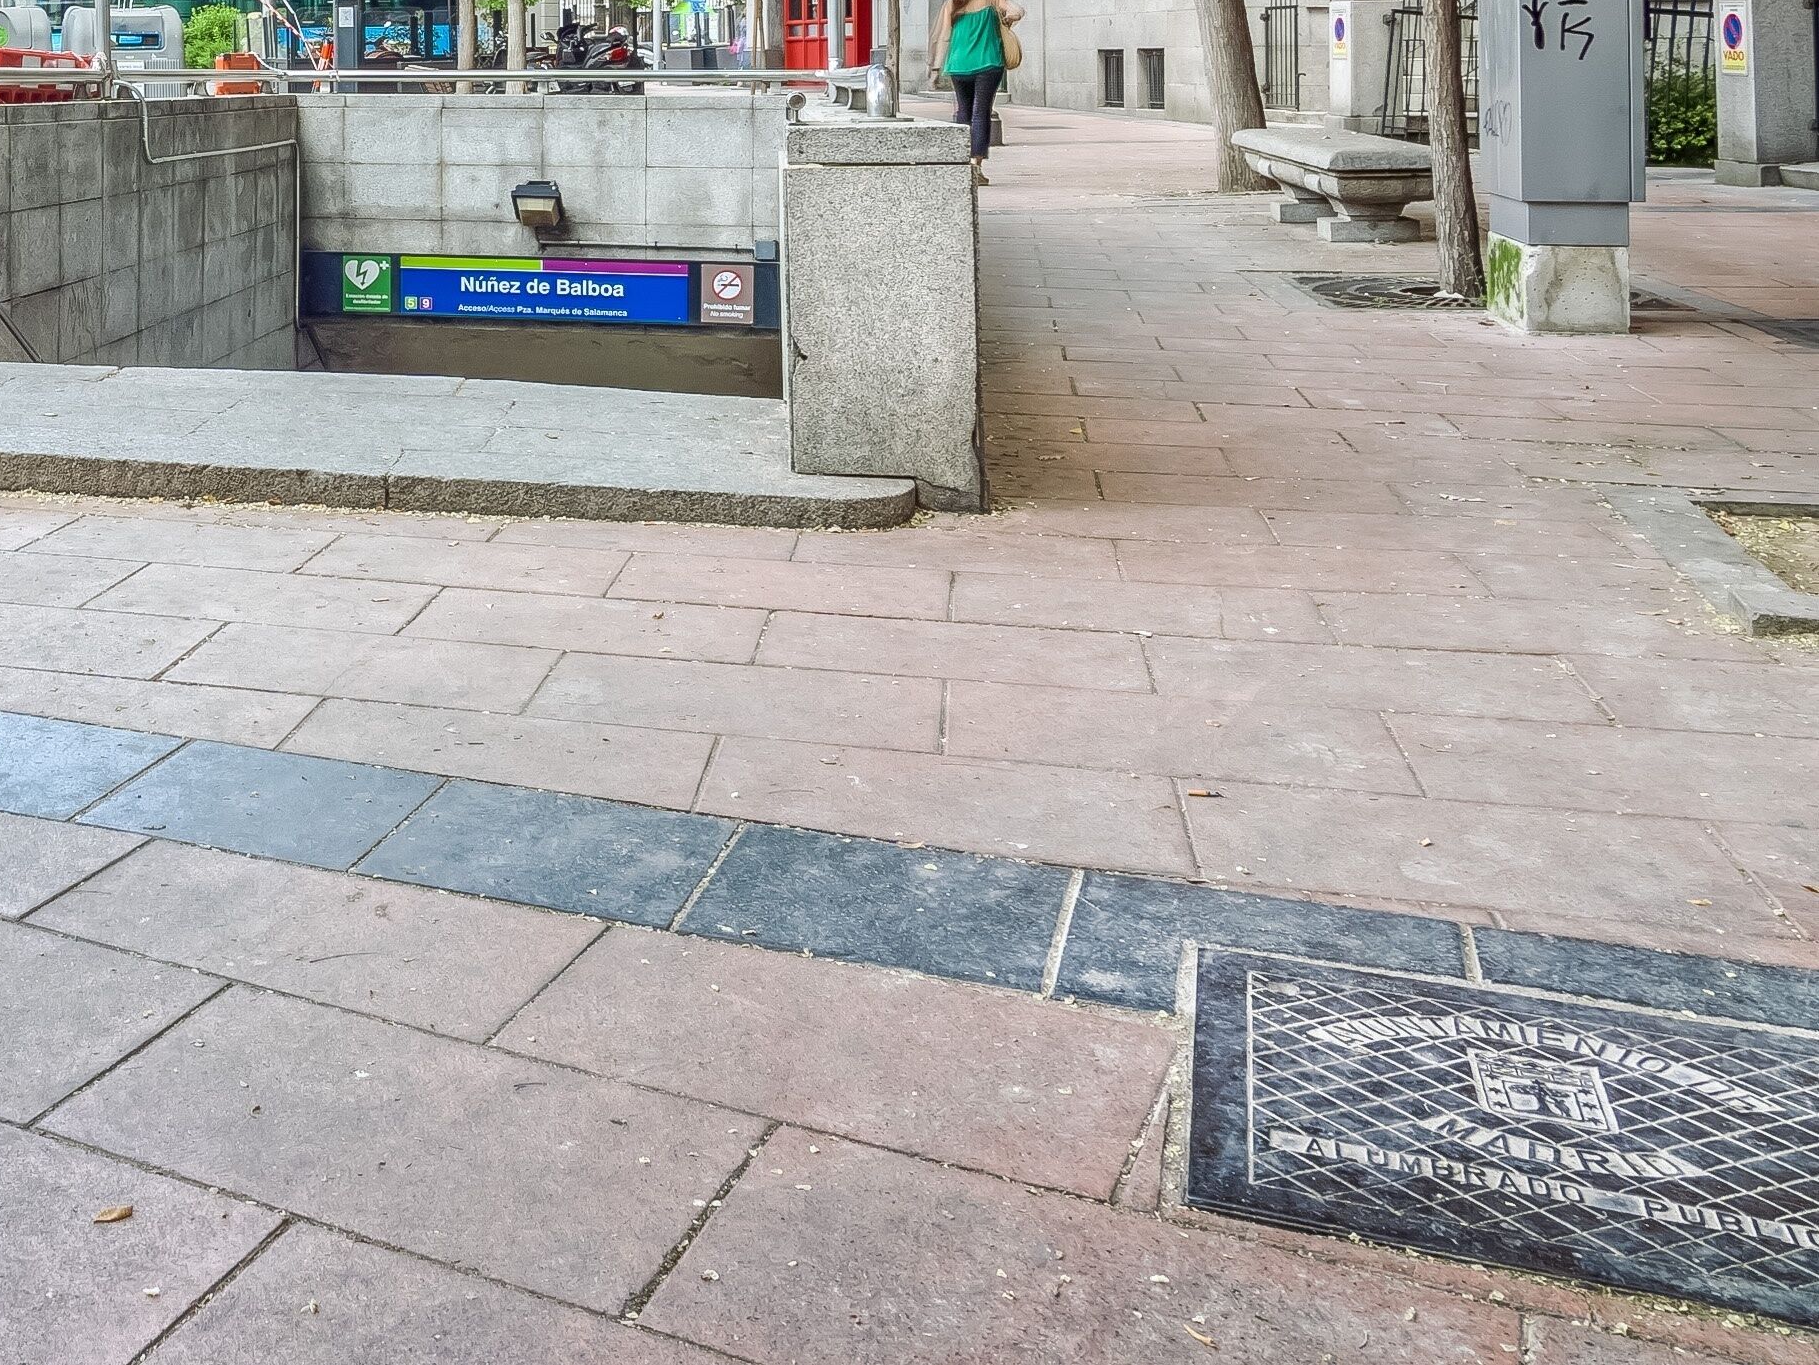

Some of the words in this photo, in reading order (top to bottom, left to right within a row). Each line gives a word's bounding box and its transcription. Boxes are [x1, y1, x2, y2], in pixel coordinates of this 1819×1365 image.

[1723, 50, 1745, 61] VADO
[460, 276, 520, 294] Núñez
[526, 279, 550, 295] de
[557, 279, 624, 297] Balboa
[406, 298, 415, 308] 5
[422, 298, 430, 309] 9
[703, 302, 733, 310] Prohibido
[458, 304, 515, 314] Acceso/Access
[517, 305, 534, 314] Pza.
[536, 306, 570, 317] Marqués
[572, 307, 582, 316] de
[584, 307, 628, 317] Salamanca
[720, 311, 744, 319] smoking
[1436, 1117, 1684, 1177] MADRID
[1305, 1137, 1585, 1204] ALUMBRADO
